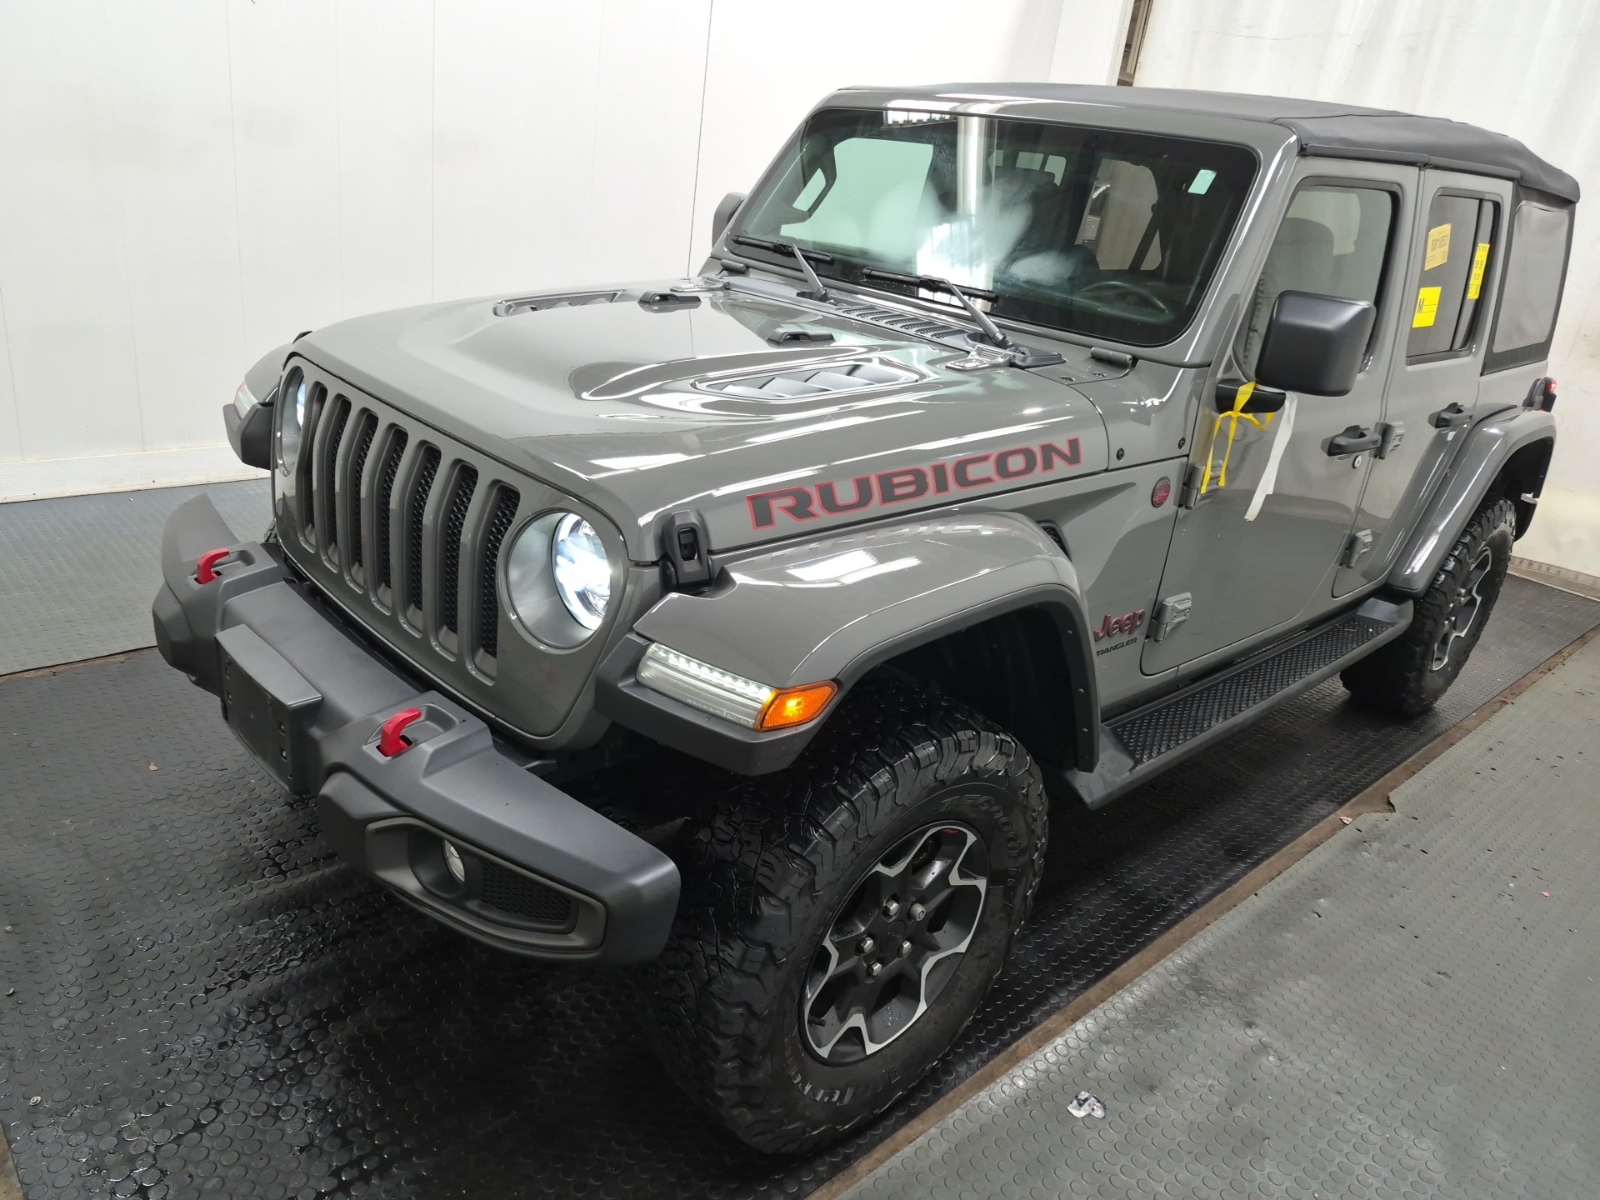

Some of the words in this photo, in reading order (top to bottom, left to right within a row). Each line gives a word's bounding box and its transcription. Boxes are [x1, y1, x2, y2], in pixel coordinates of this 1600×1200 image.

[746, 437, 1081, 530] RUBICON
[1093, 609, 1146, 642] Jeep
[1096, 637, 1138, 657] RANGLER
